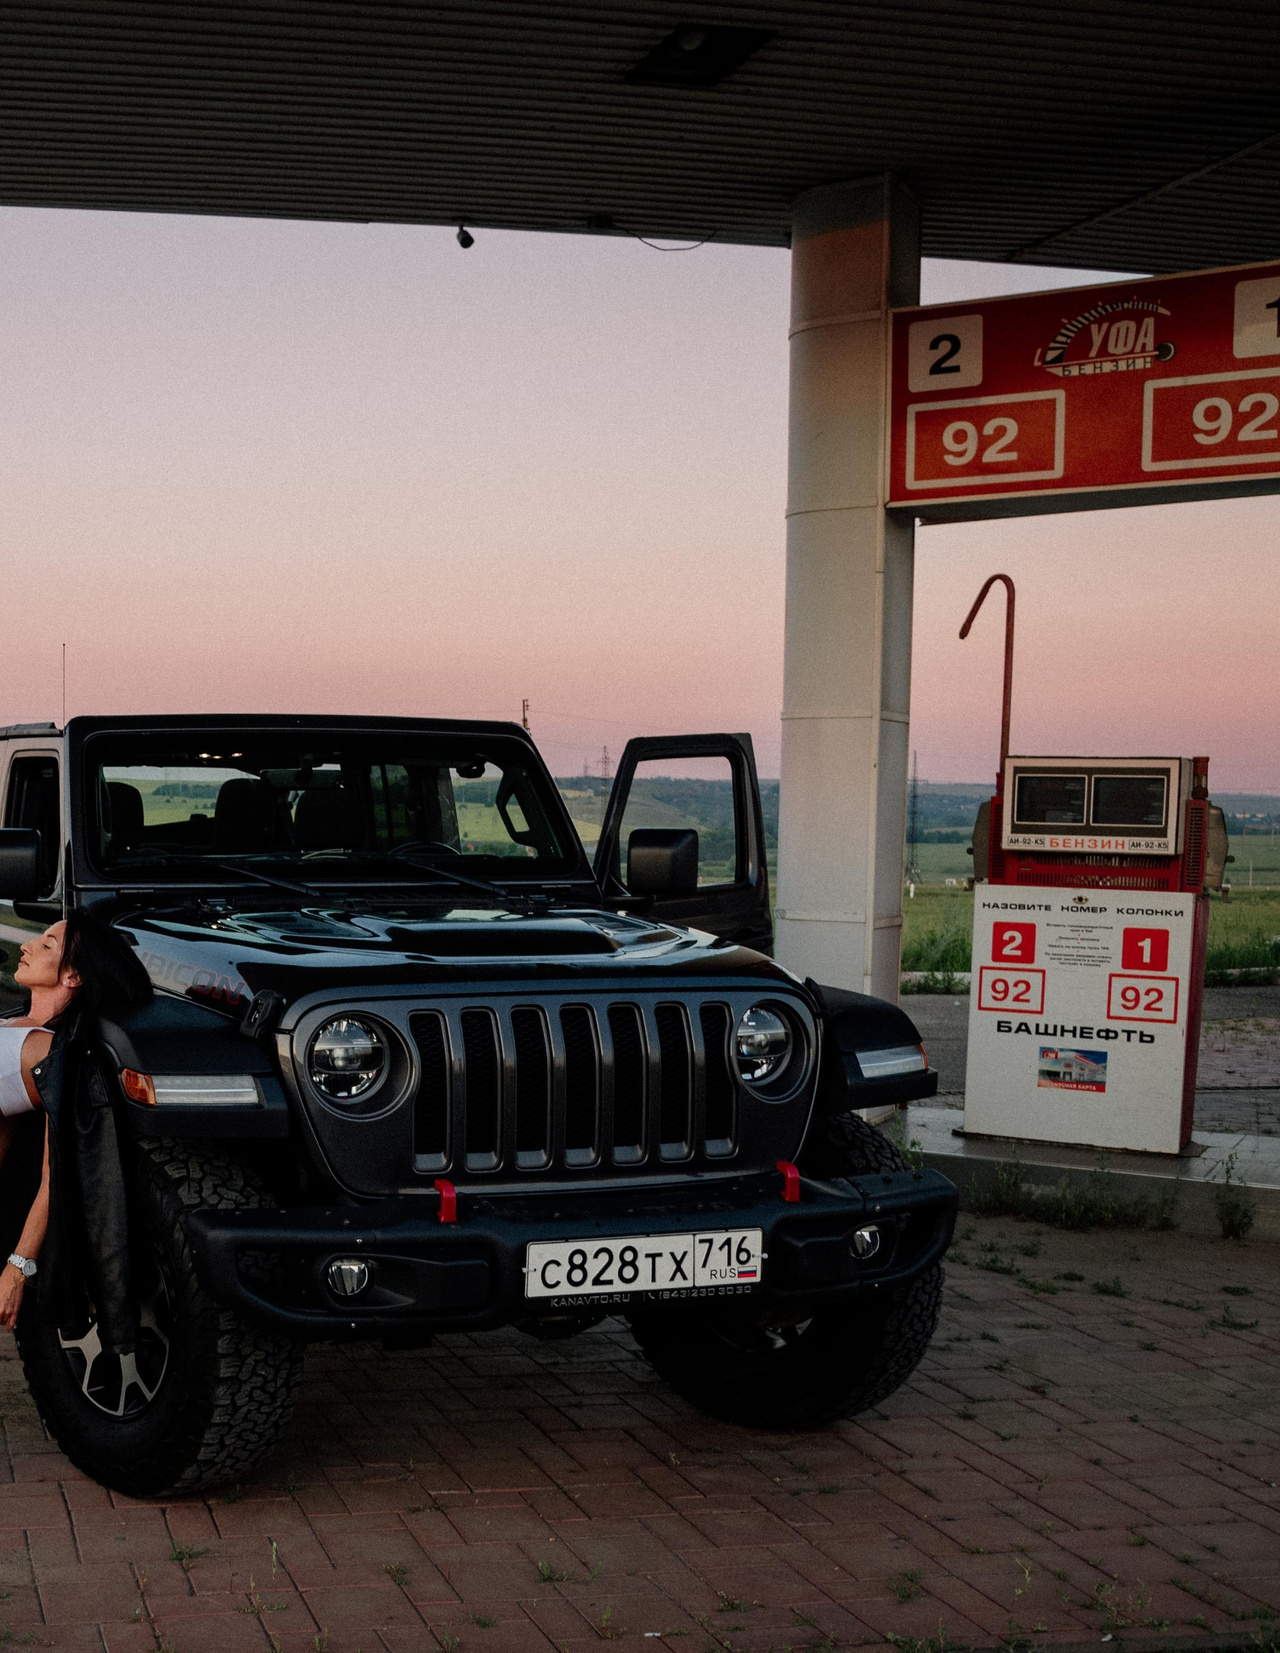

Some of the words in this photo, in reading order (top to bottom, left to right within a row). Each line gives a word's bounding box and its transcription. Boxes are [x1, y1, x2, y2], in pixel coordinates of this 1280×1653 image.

[1088, 317, 1155, 358] УФА
[928, 333, 962, 376] 2
[1061, 357, 1153, 377] БЕНЗИН
[1192, 392, 1279, 445] 92
[942, 417, 1019, 466] 92
[1049, 838, 1126, 850] БЕНЗИН
[982, 901, 1052, 912] НАЗОВИТЕ
[1060, 904, 1107, 914] НОМЕР
[1116, 907, 1184, 917] КОЛОНКИ
[1001, 930, 1023, 956] 2
[1137, 937, 1152, 964] 1
[132, 947, 247, 1004] BICON
[990, 978, 1031, 1003] 92
[1120, 986, 1164, 1012] 92
[996, 1020, 1155, 1044] БАШНЕФТЬ
[698, 1236, 752, 1269] 716
[710, 1268, 736, 1280] RUS
[550, 1293, 630, 1308] KANAVTO.RU
